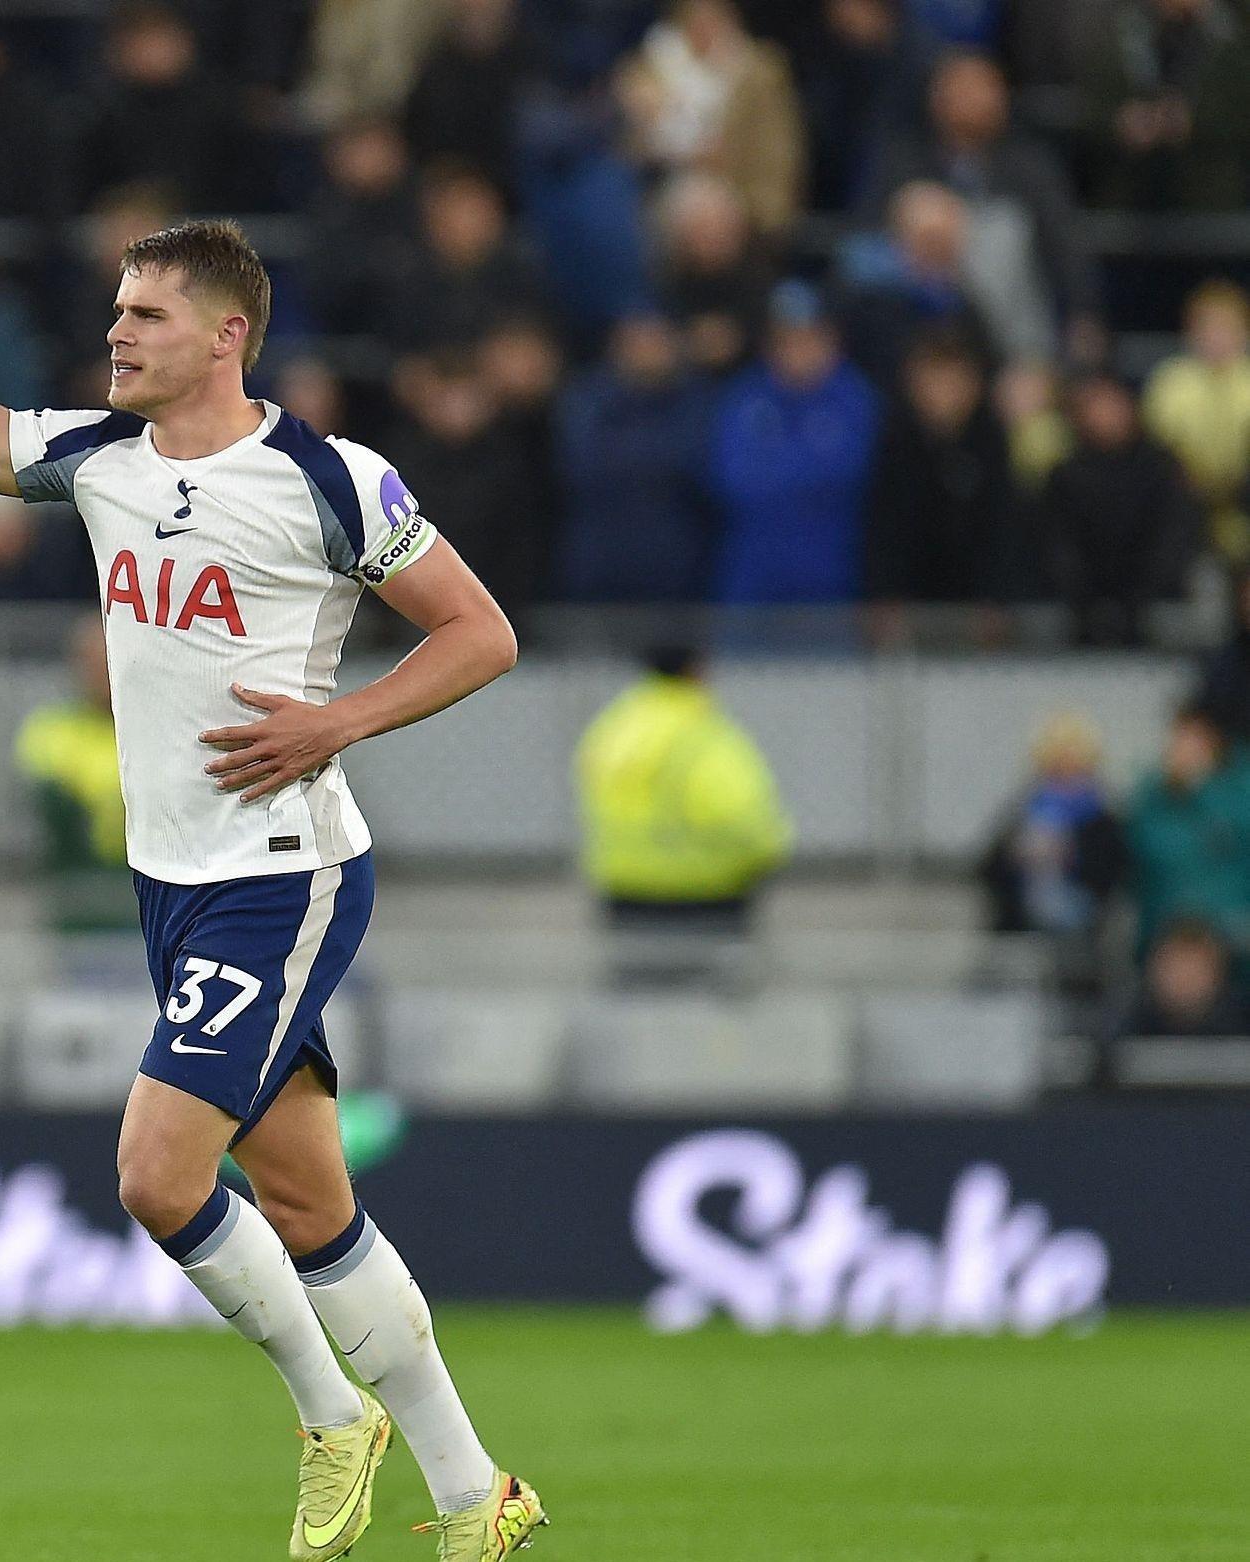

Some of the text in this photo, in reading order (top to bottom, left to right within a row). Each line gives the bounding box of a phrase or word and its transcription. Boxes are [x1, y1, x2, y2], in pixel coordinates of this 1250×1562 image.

[106, 549, 247, 637] AIA
[165, 956, 264, 1037] 37
[632, 1128, 1110, 1336] Stake
